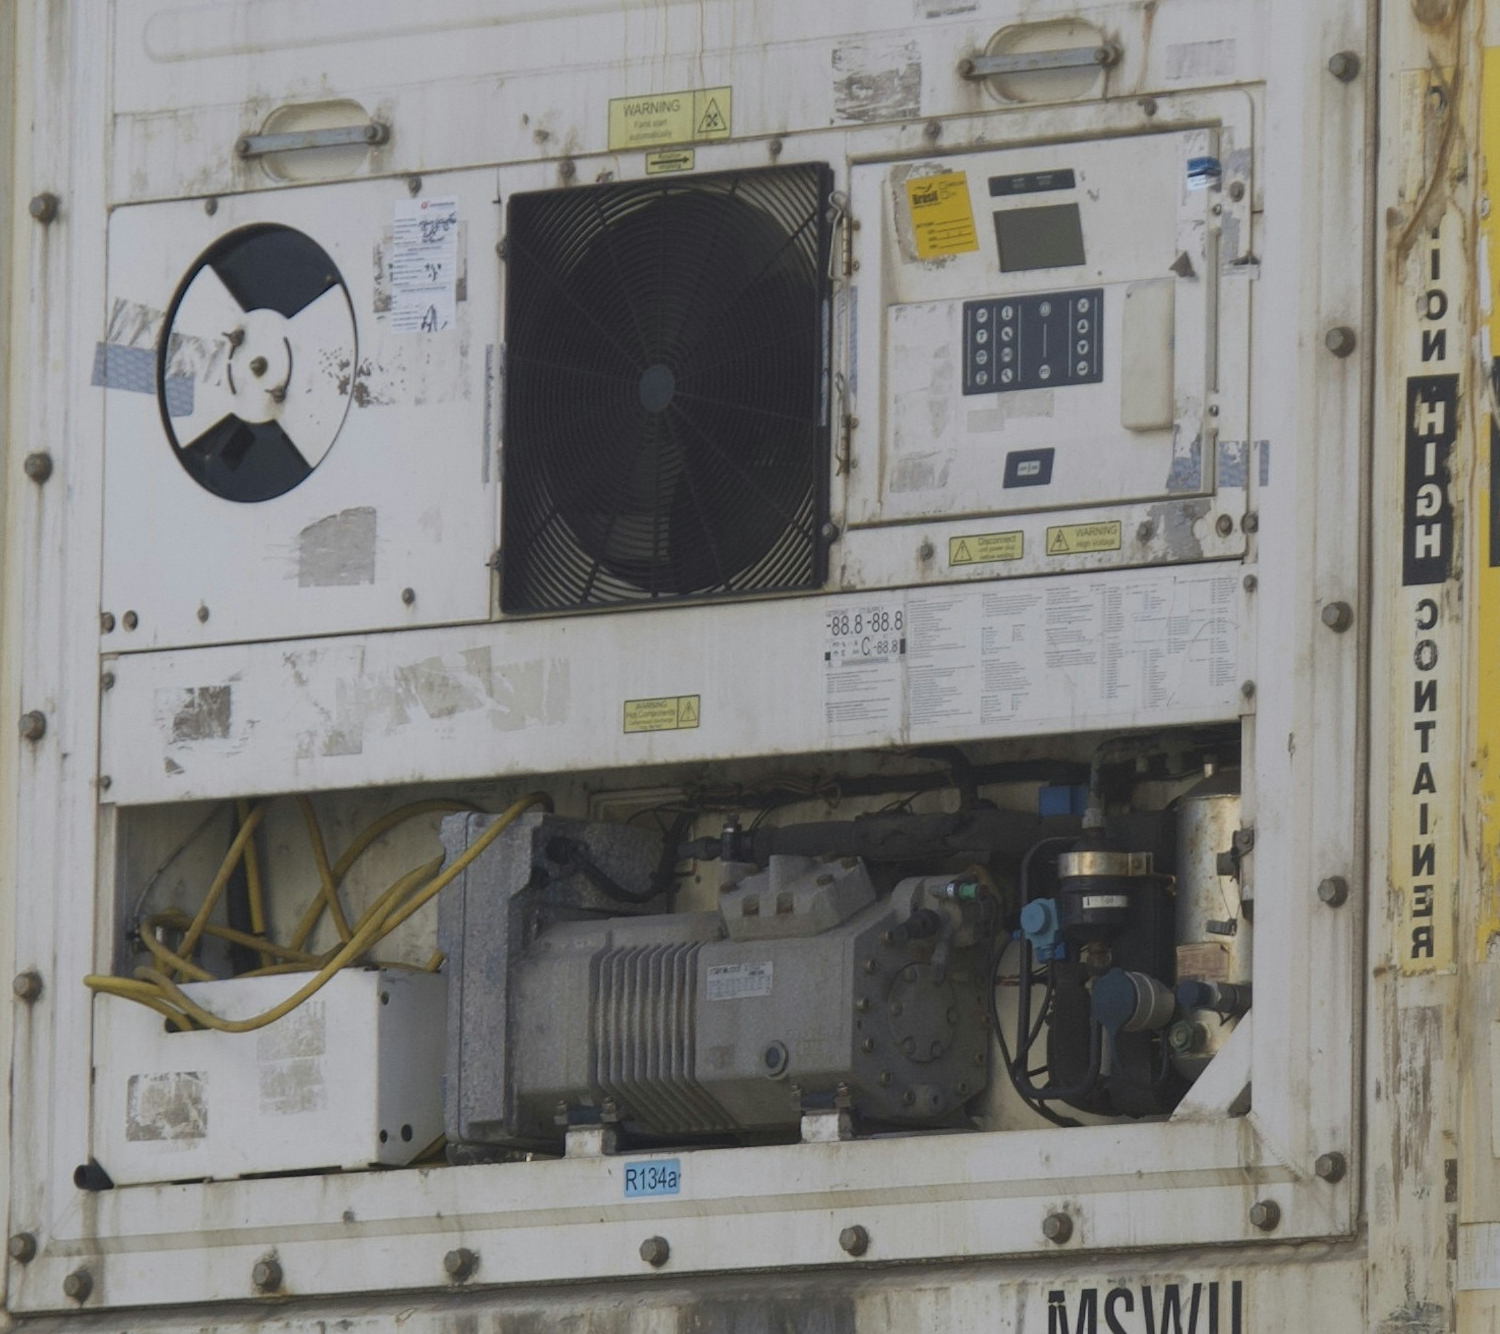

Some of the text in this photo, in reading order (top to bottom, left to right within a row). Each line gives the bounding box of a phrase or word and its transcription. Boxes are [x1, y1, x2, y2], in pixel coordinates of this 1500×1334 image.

[623, 99, 681, 117] WARNING
[1075, 525, 1117, 537] WARNING
[624, 1166, 678, 1192] R134a
